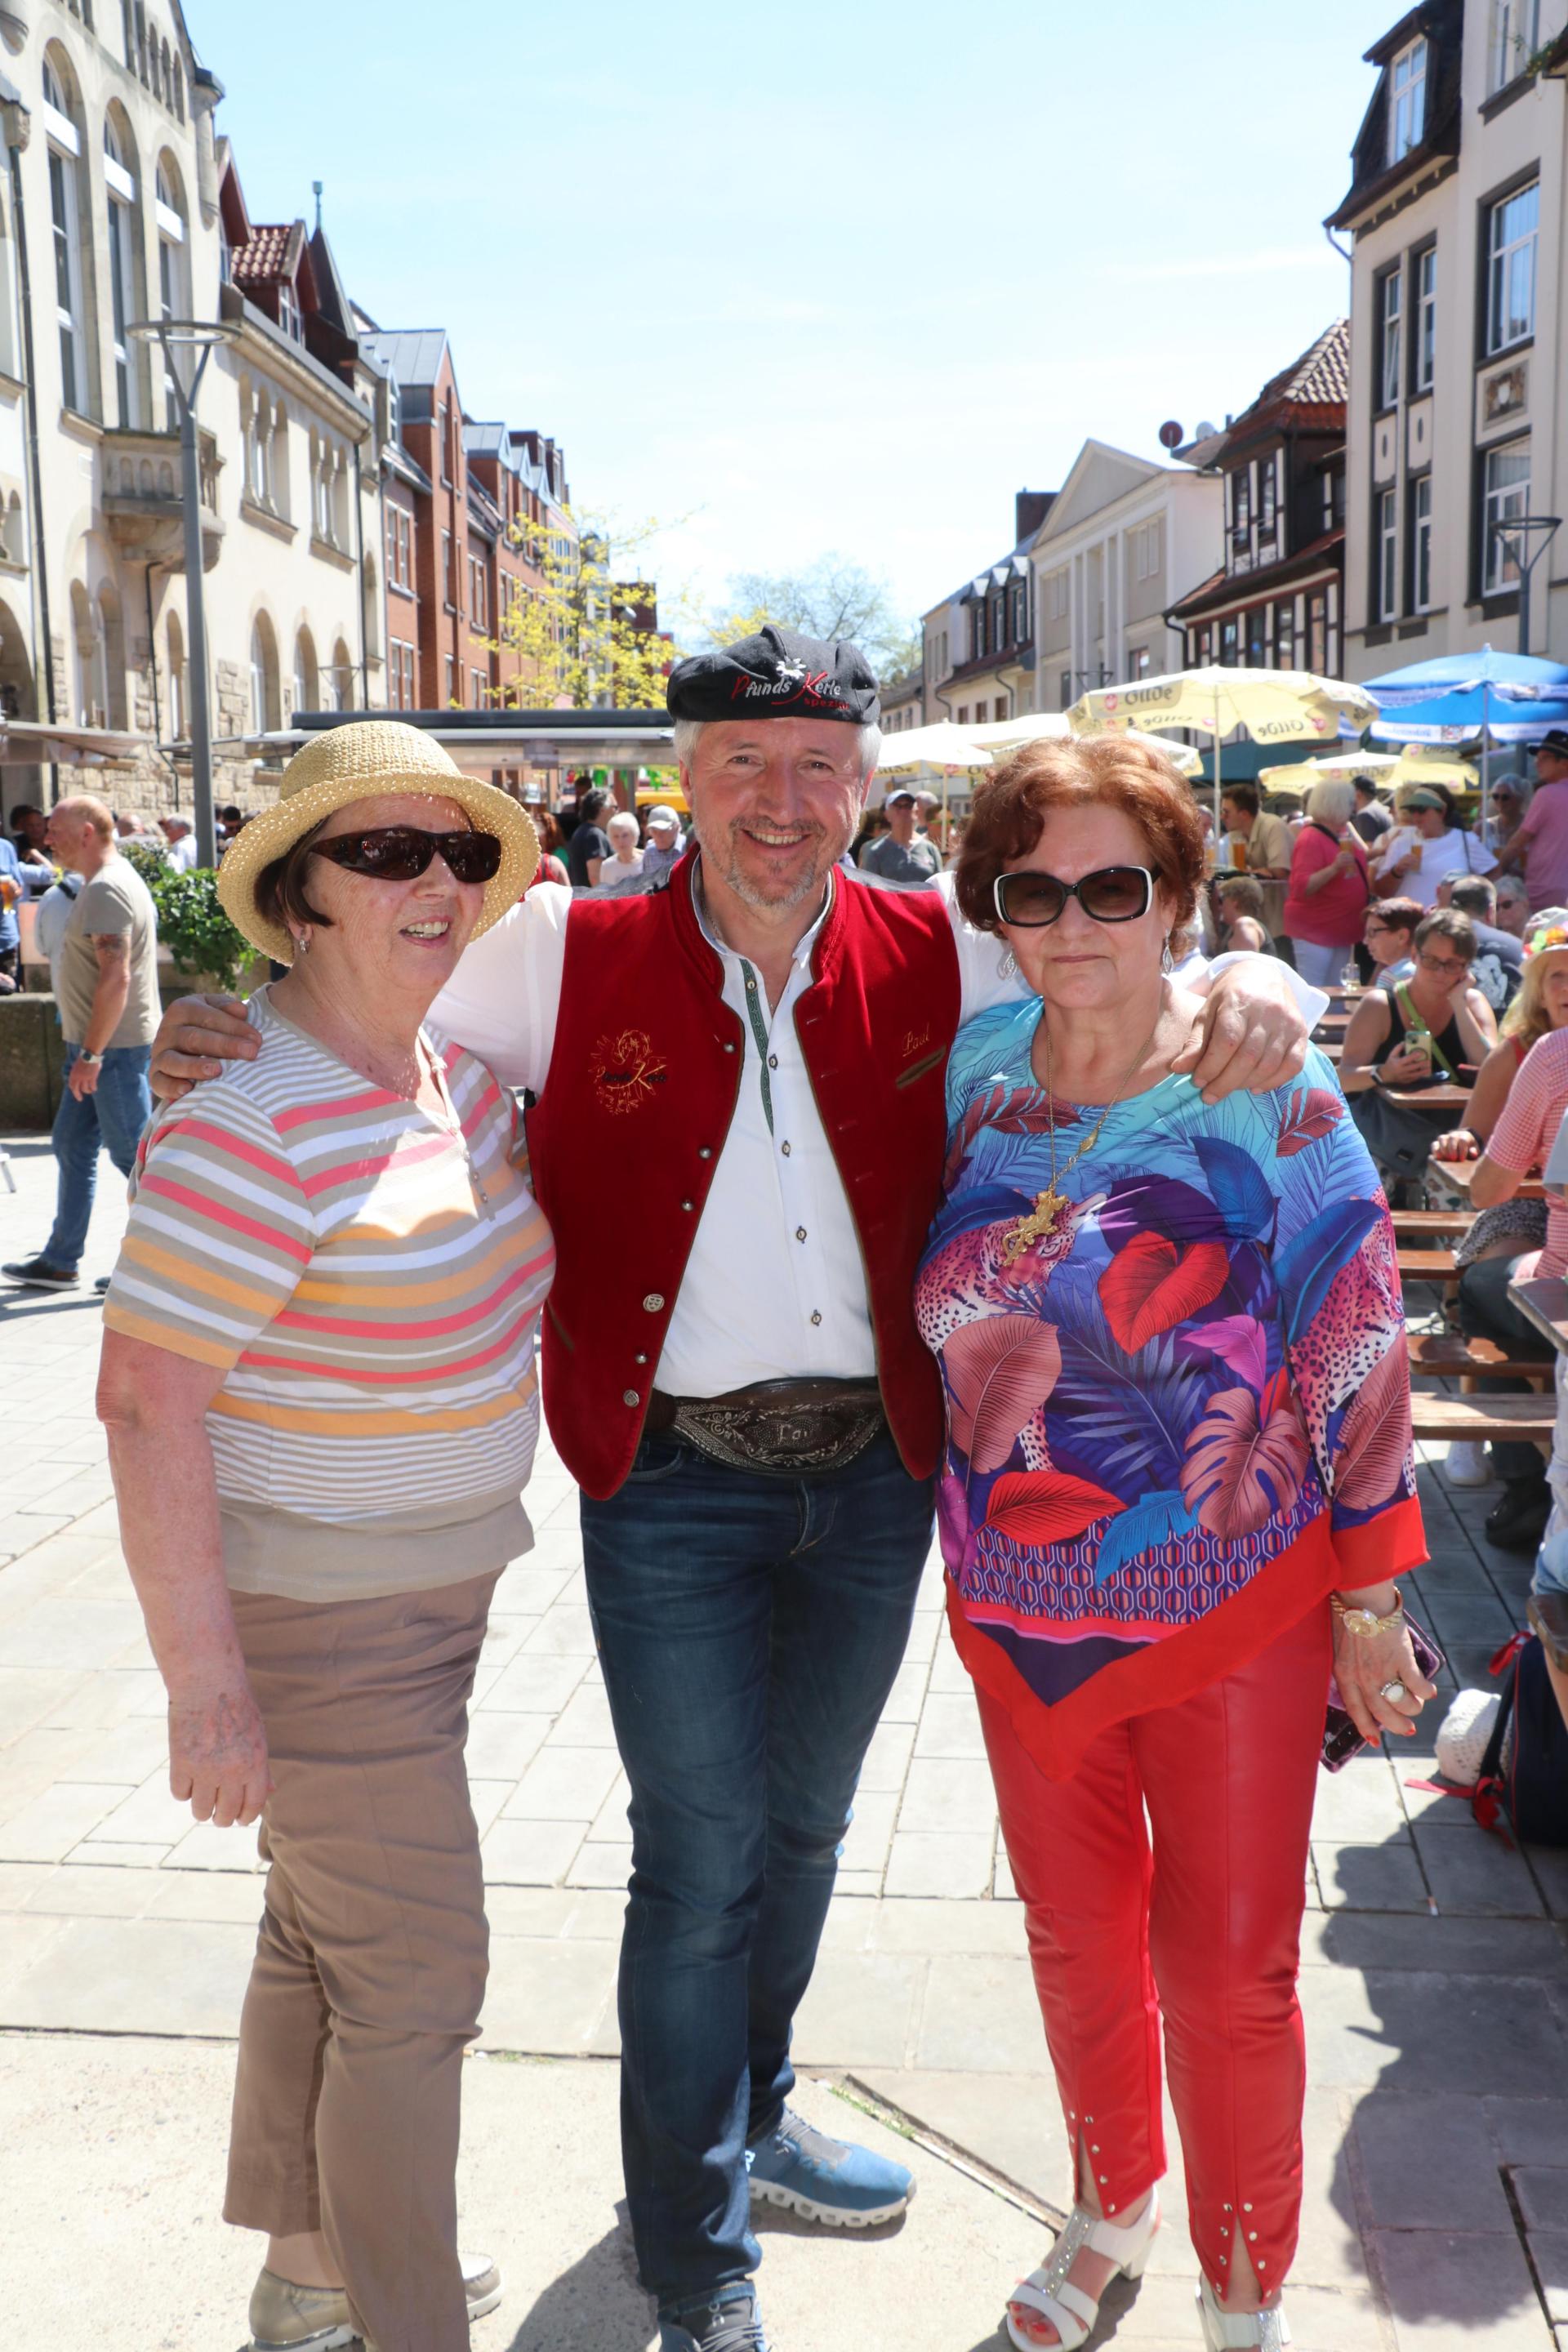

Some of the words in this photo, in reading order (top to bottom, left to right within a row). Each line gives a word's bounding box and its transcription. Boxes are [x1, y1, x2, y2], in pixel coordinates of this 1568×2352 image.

[731, 675, 792, 700] Pfunds
[1124, 686, 1173, 706] Gilde
[902, 1021, 930, 1058] Paul
